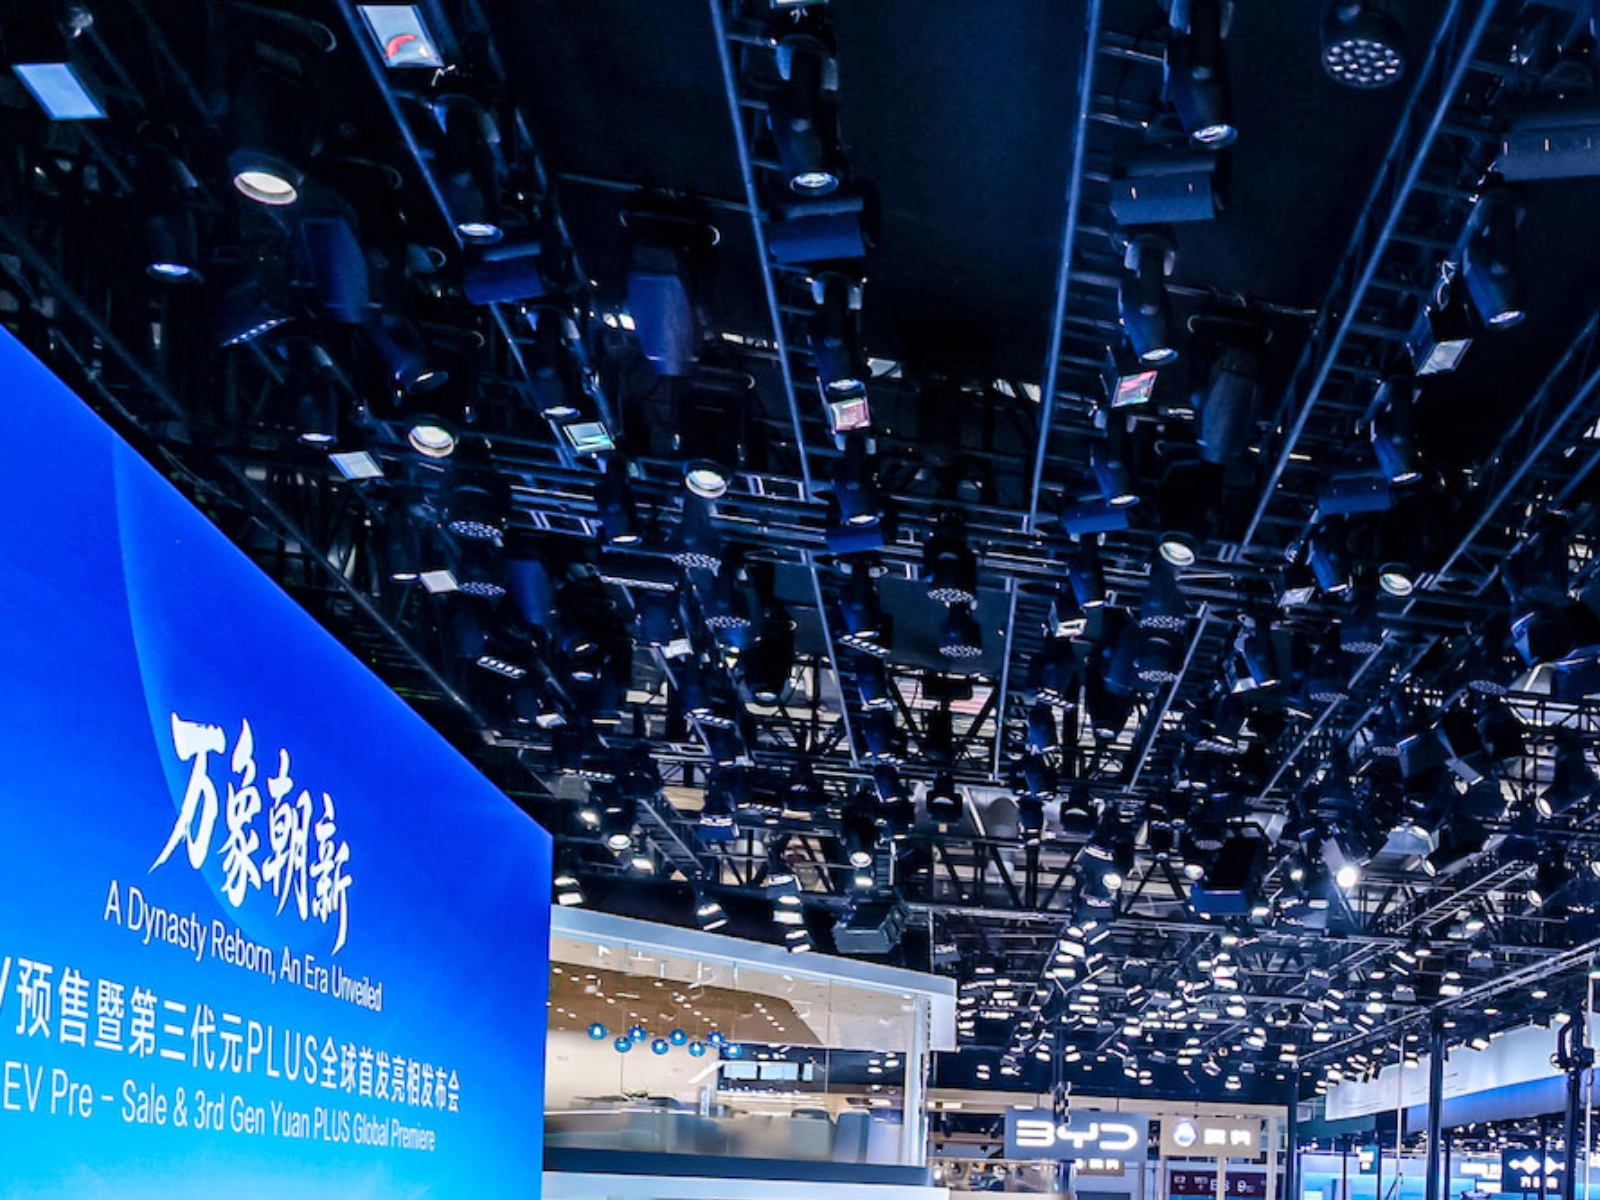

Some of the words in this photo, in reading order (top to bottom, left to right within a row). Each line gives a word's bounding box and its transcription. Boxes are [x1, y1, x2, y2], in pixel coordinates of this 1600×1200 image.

[150, 712, 352, 955] 万象朝新
[104, 879, 121, 925] A
[127, 886, 208, 962] Dynasty
[211, 919, 277, 985] Reborn,
[280, 945, 301, 985] An
[305, 953, 329, 994] Era
[332, 964, 382, 1012] Unveiled
[3, 1060, 43, 1113] EV
[50, 1068, 93, 1118] Pre
[121, 1079, 167, 1126] Sale
[173, 1086, 188, 1127] &
[194, 1089, 225, 1131] 3rd
[230, 1095, 265, 1135] Gen
[270, 1099, 310, 1139] Yuan
[314, 1106, 350, 1143] PLUS
[353, 1112, 389, 1147] Global
[391, 1118, 436, 1152] Premiere
[1016, 1119, 1138, 1151] BYD
